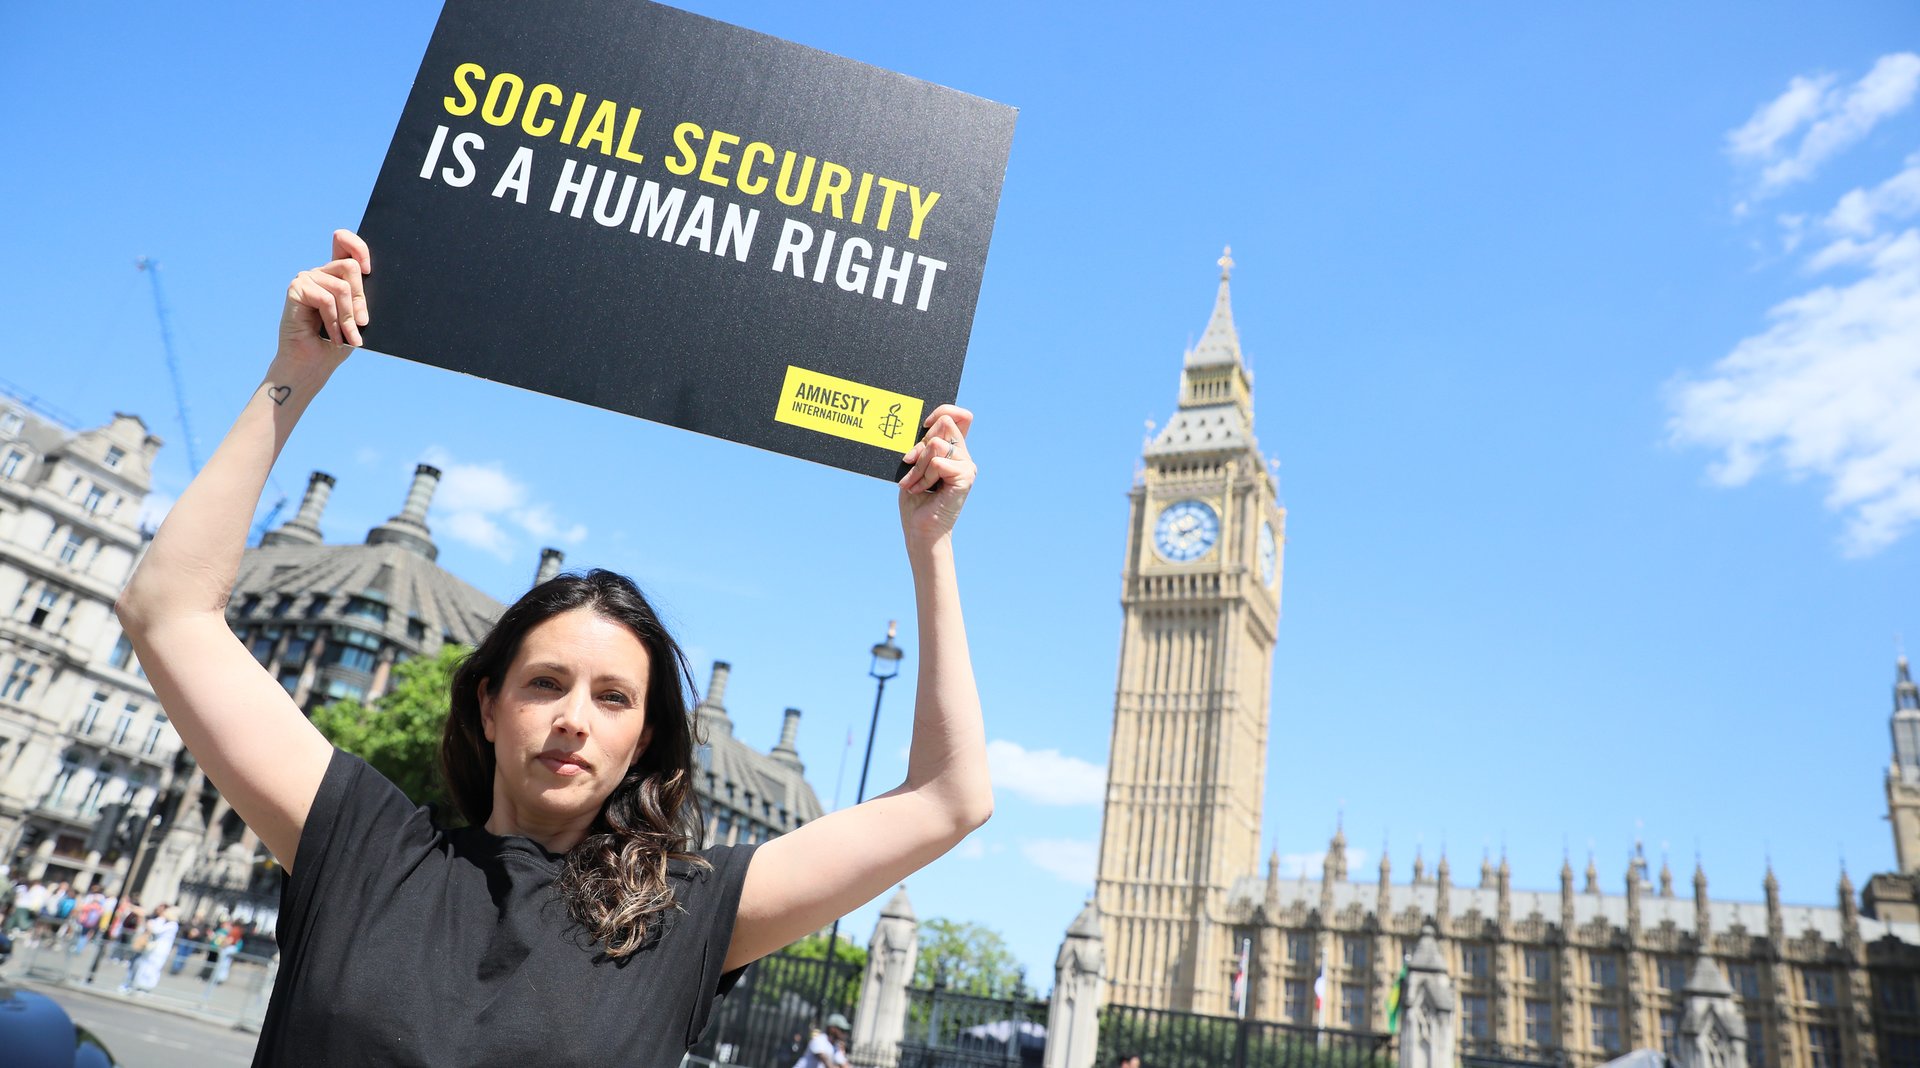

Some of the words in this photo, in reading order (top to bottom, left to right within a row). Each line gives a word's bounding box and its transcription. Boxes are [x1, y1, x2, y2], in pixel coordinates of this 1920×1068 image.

[443, 62, 644, 164] SOCIAL
[664, 122, 941, 241] SECURITY
[419, 125, 485, 188] IS
[492, 146, 534, 205] A
[549, 159, 760, 263] HUMAN
[772, 217, 948, 312] RIGHT
[792, 401, 864, 429] INTERNATIONAL
[795, 382, 870, 415] AMNESTY
